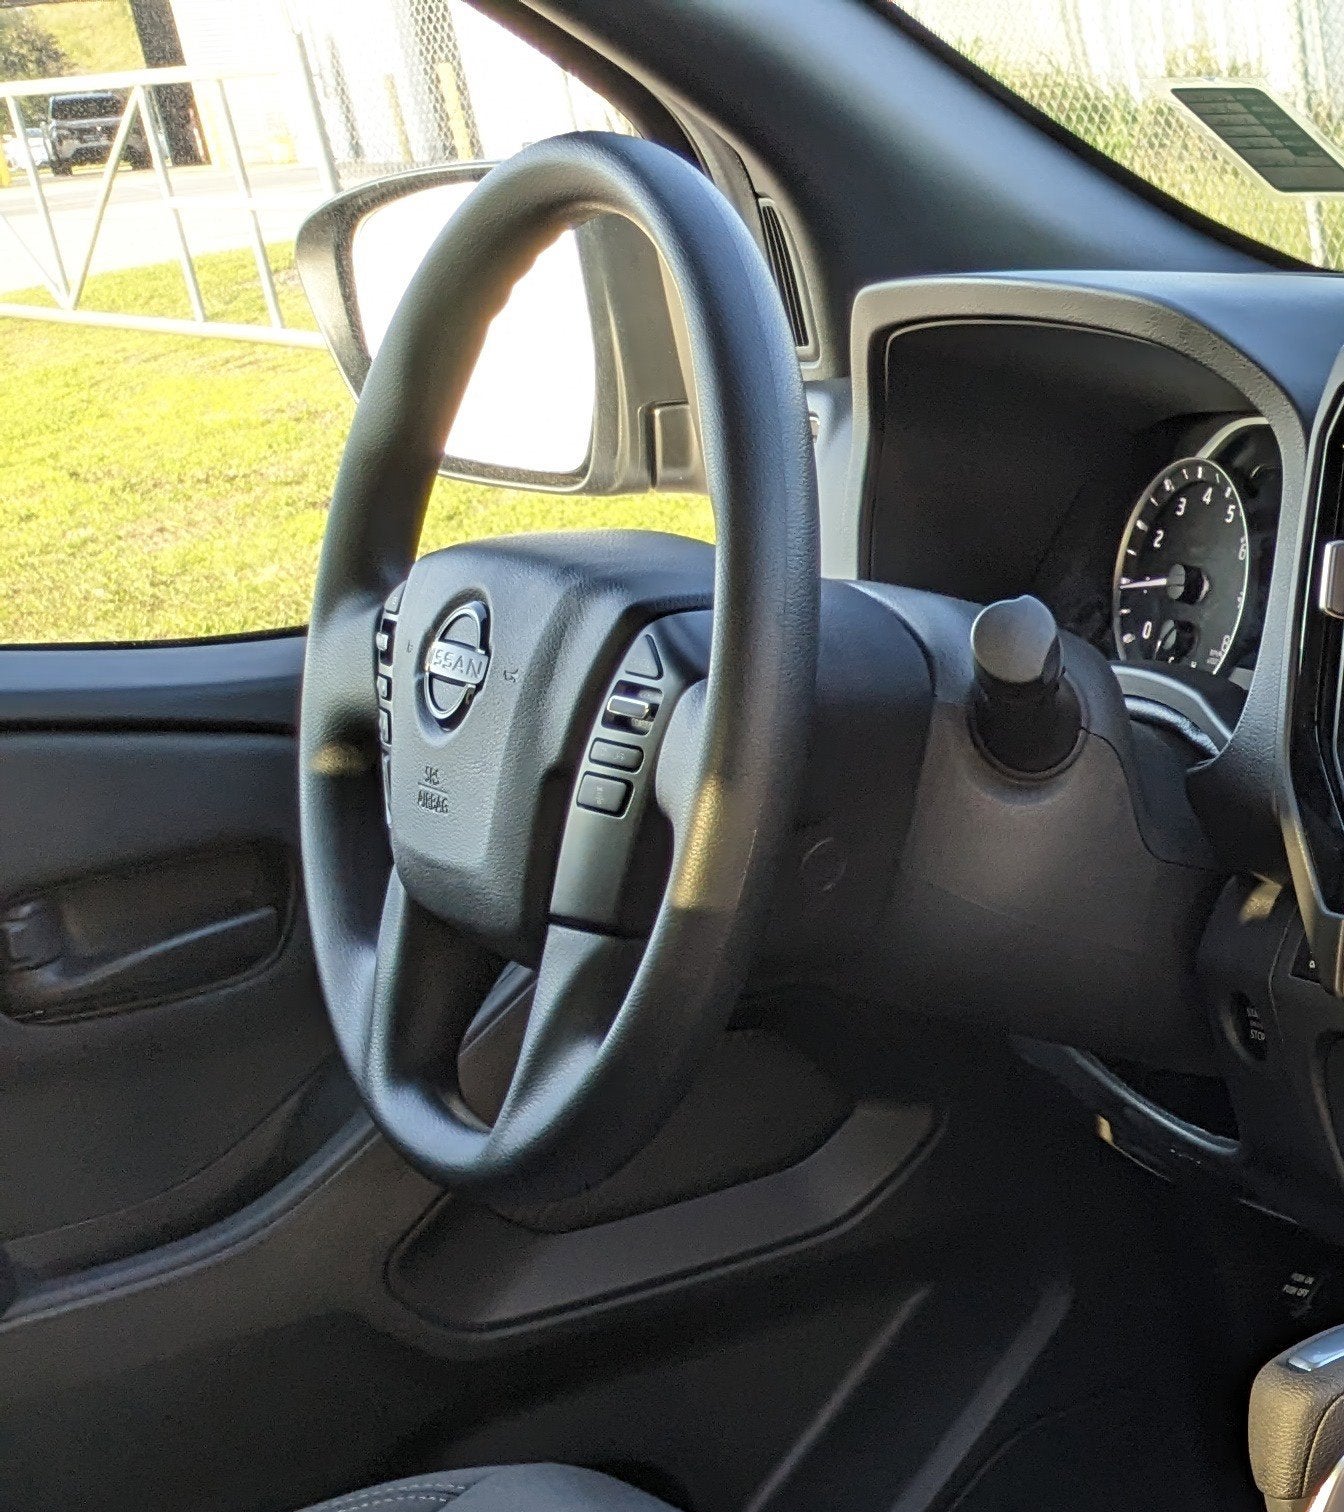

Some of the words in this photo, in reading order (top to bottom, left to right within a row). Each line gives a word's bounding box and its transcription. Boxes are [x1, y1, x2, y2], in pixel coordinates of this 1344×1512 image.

[1202, 486, 1213, 506] 4
[1174, 496, 1188, 518] 3
[1224, 504, 1236, 524] 5
[1152, 529, 1165, 549] 2
[1141, 620, 1153, 640] 0
[431, 648, 484, 680] SSAN
